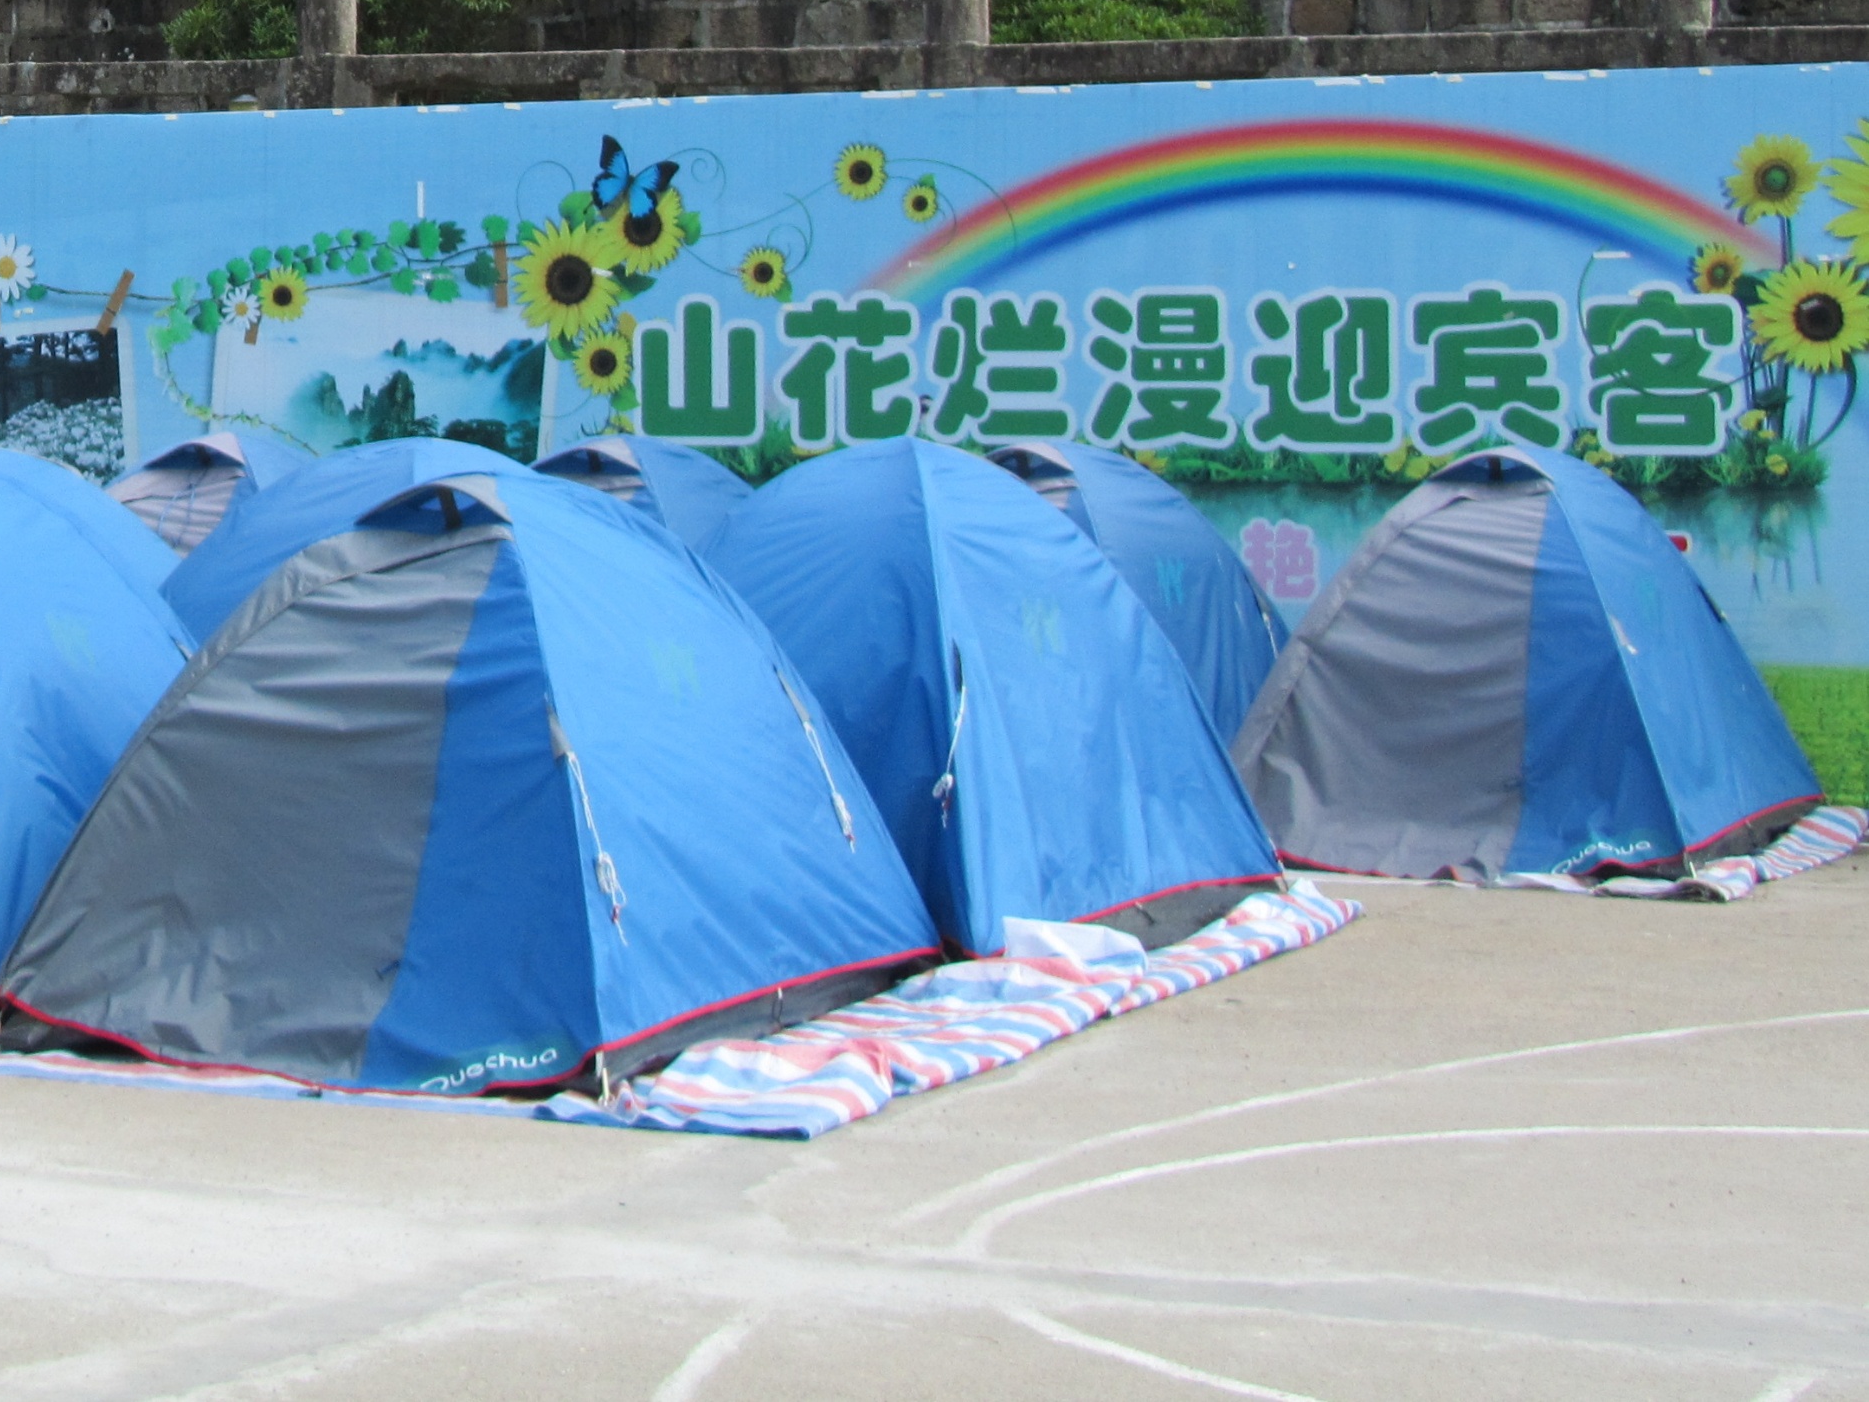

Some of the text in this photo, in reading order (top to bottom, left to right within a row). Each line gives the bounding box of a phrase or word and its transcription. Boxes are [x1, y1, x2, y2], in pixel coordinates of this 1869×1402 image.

[640, 288, 1736, 448] 山花烂漫迎宾客
